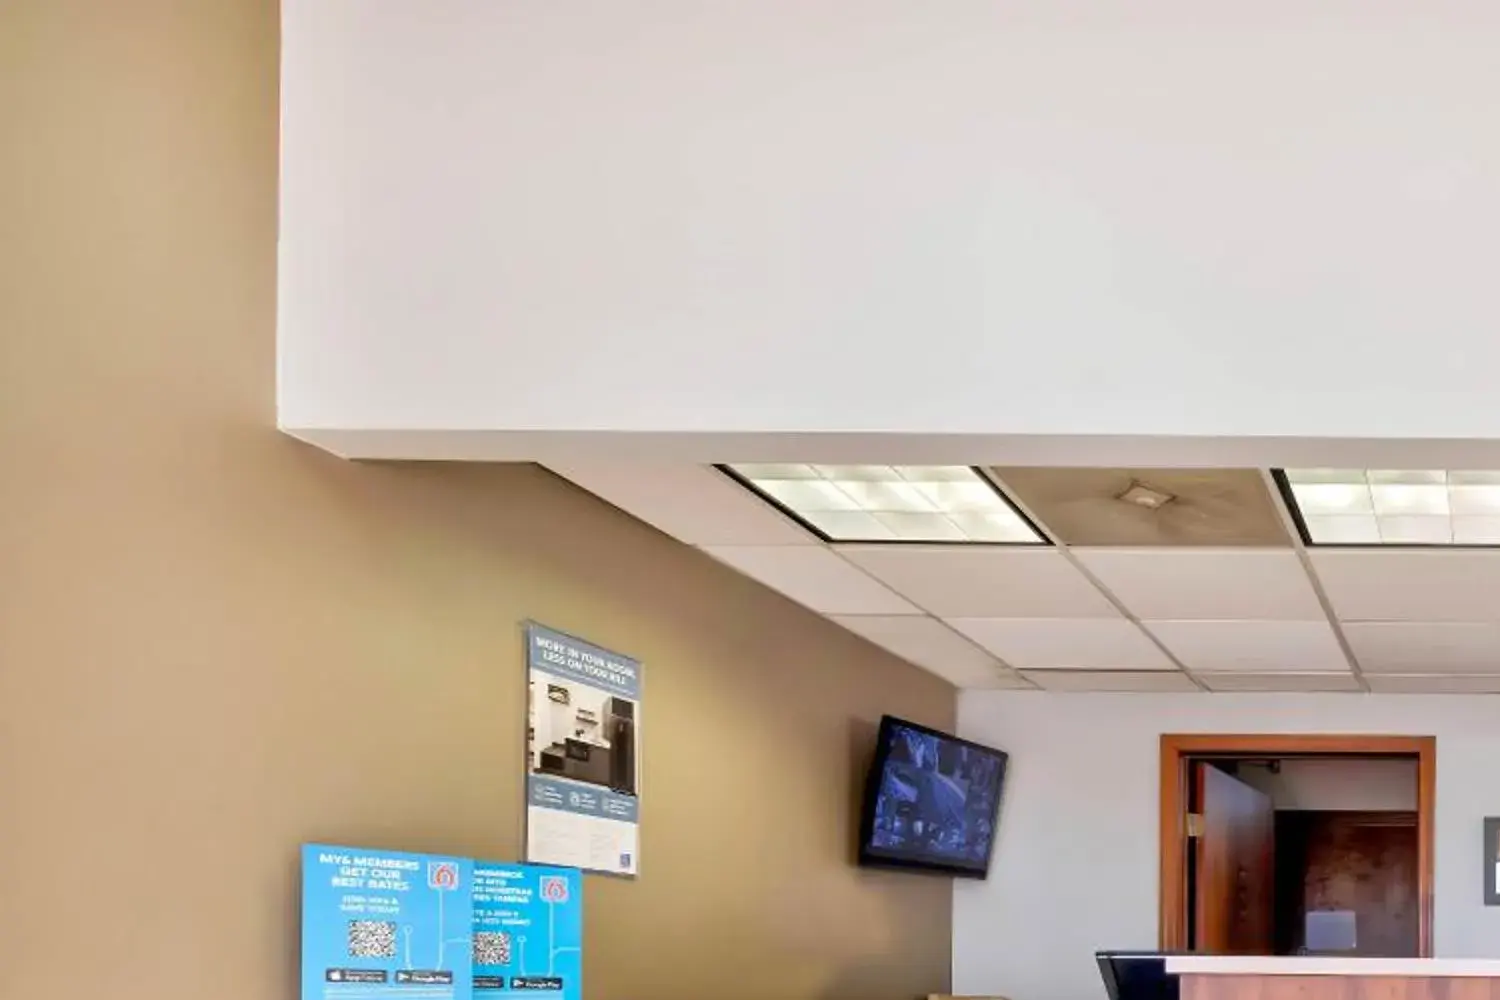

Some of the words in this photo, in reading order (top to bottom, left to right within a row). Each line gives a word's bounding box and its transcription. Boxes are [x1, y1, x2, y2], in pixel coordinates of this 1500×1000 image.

[535, 636, 565, 654] MORE
[567, 647, 579, 658] IN
[581, 652, 604, 668] YOUR
[543, 649, 565, 665] LESS
[567, 659, 582, 671] ON
[584, 663, 608, 679] YOUR
[319, 853, 351, 866] MY6
[353, 857, 420, 871] MEMBERS
[340, 866, 367, 876] GET
[370, 869, 401, 880] OUR
[331, 876, 365, 888] BEST
[367, 879, 411, 891] RATES
